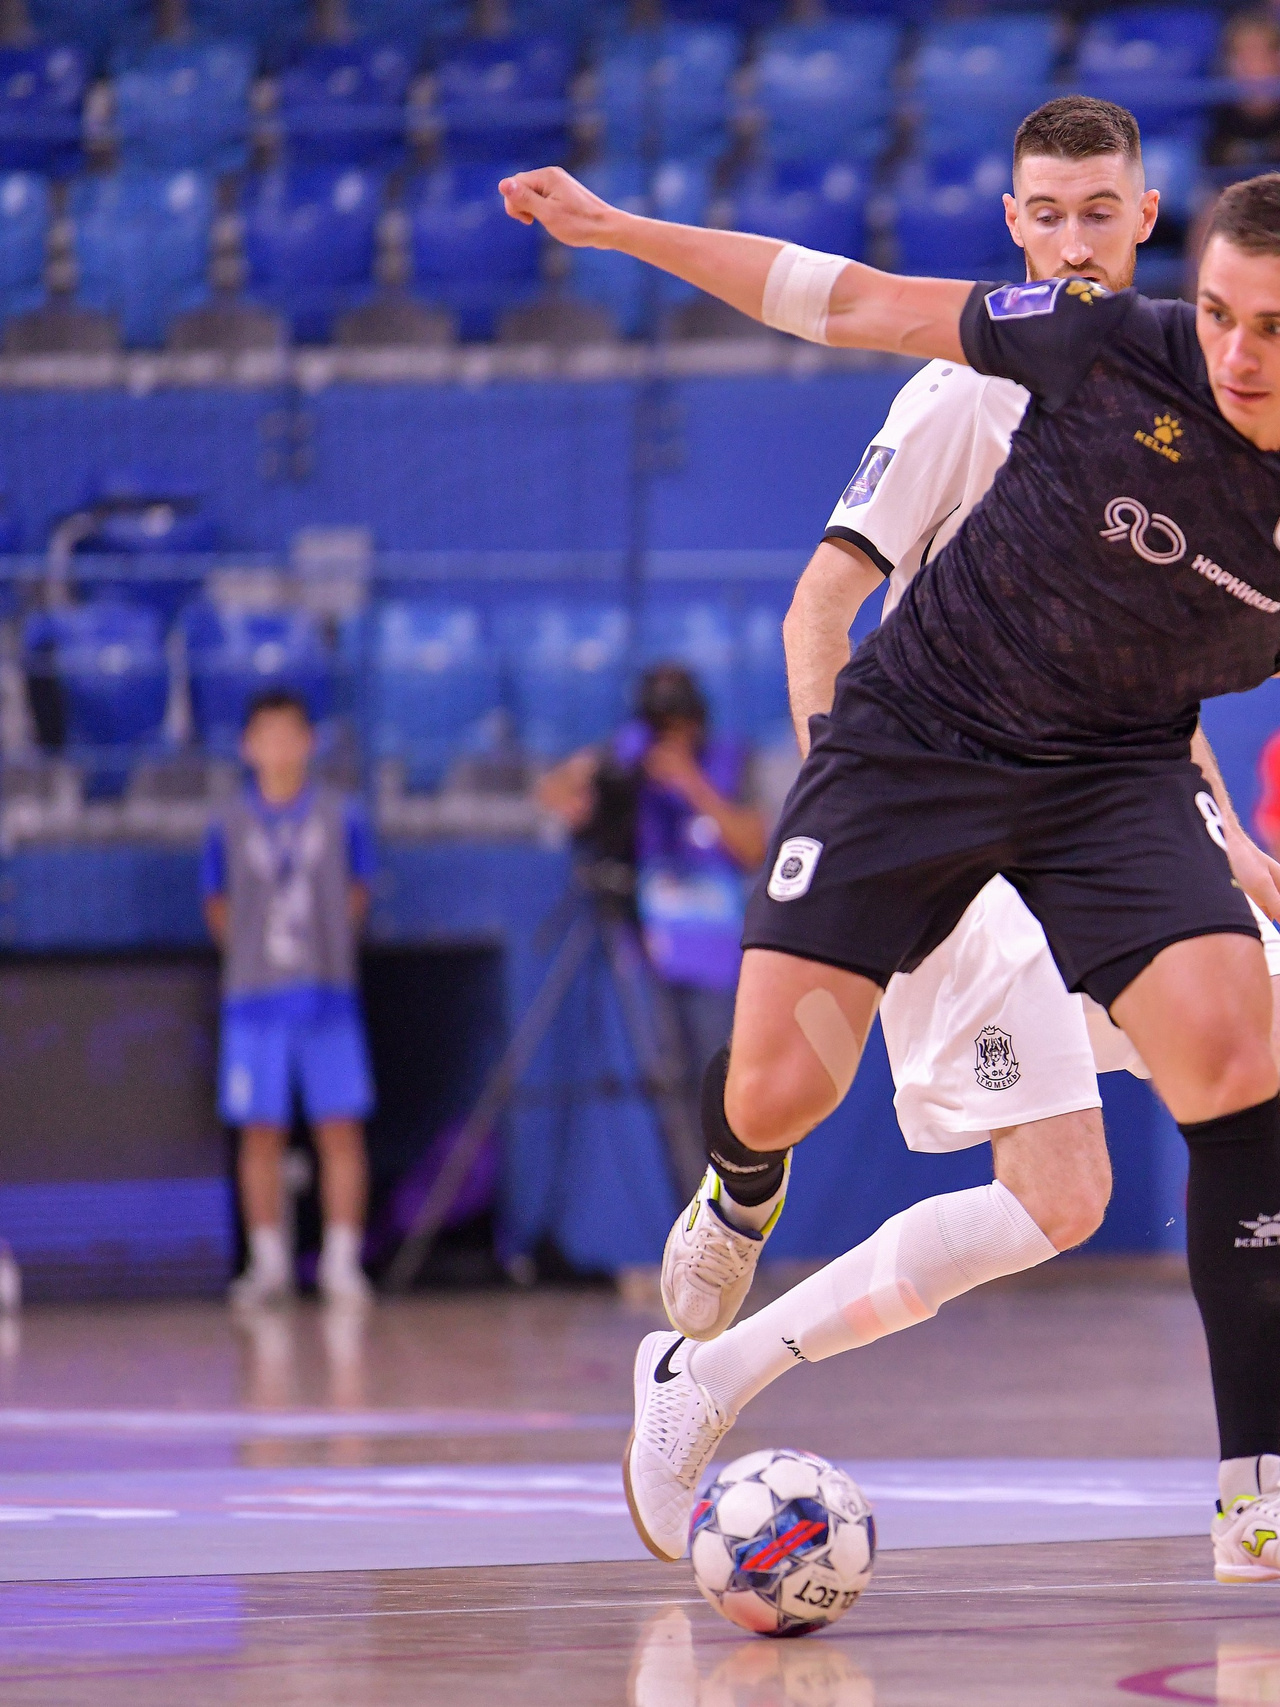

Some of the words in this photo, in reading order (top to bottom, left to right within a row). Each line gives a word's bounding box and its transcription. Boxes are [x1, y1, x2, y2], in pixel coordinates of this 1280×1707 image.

[1134, 430, 1181, 463] KELME
[1194, 790, 1229, 852] 8
[980, 1073, 1018, 1089] ТЮМЕНЬ
[991, 1069, 1004, 1077] ФК
